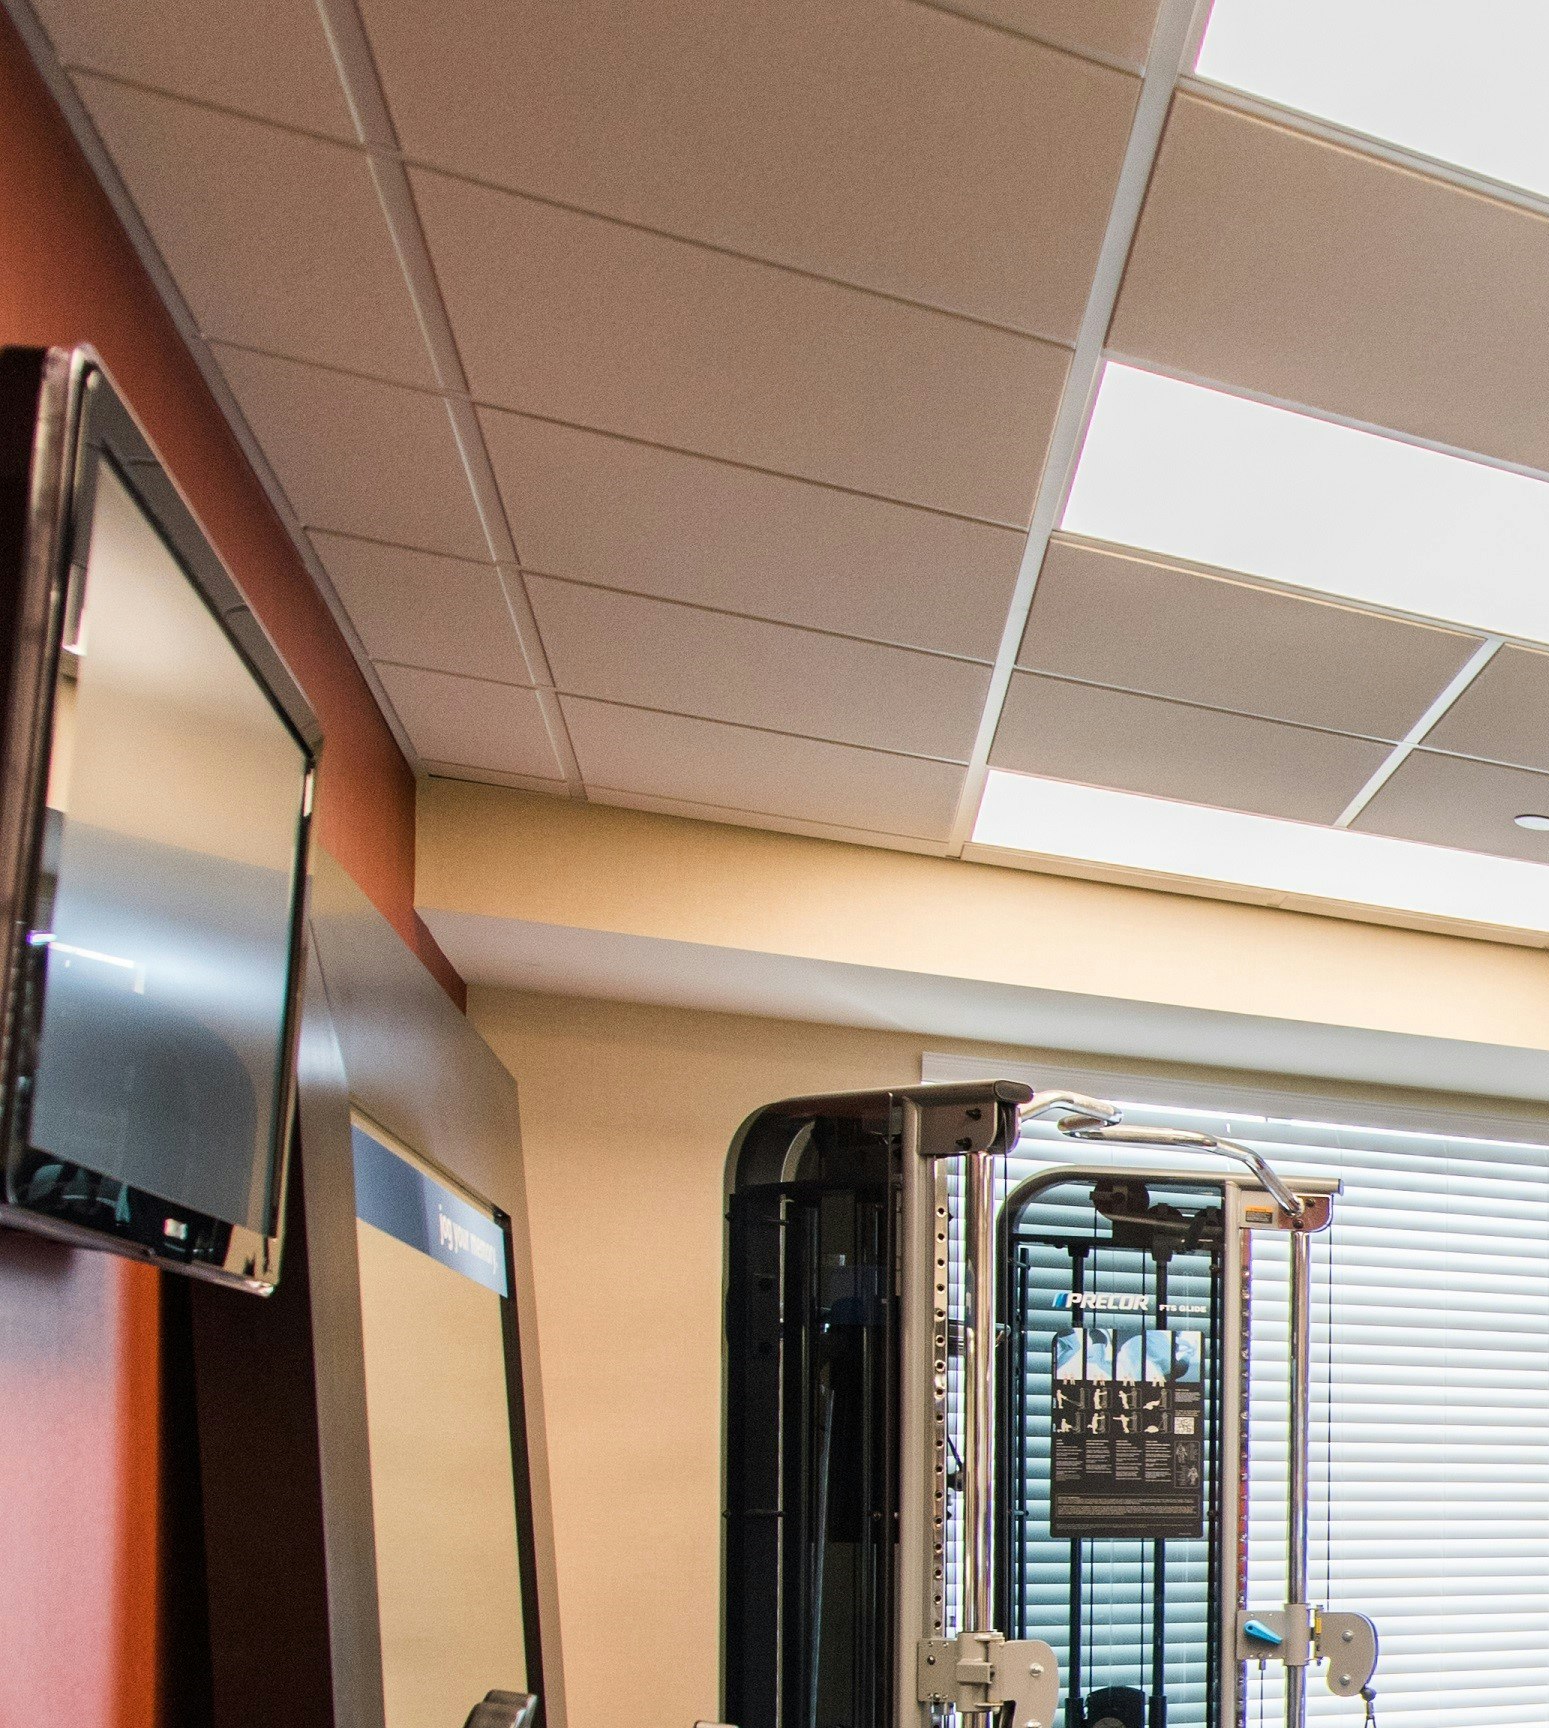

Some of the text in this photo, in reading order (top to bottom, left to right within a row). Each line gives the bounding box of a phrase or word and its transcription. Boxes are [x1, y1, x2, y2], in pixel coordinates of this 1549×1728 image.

[1066, 1292, 1149, 1311] PRECOR
[1159, 1304, 1207, 1314] FTS GLIDE
